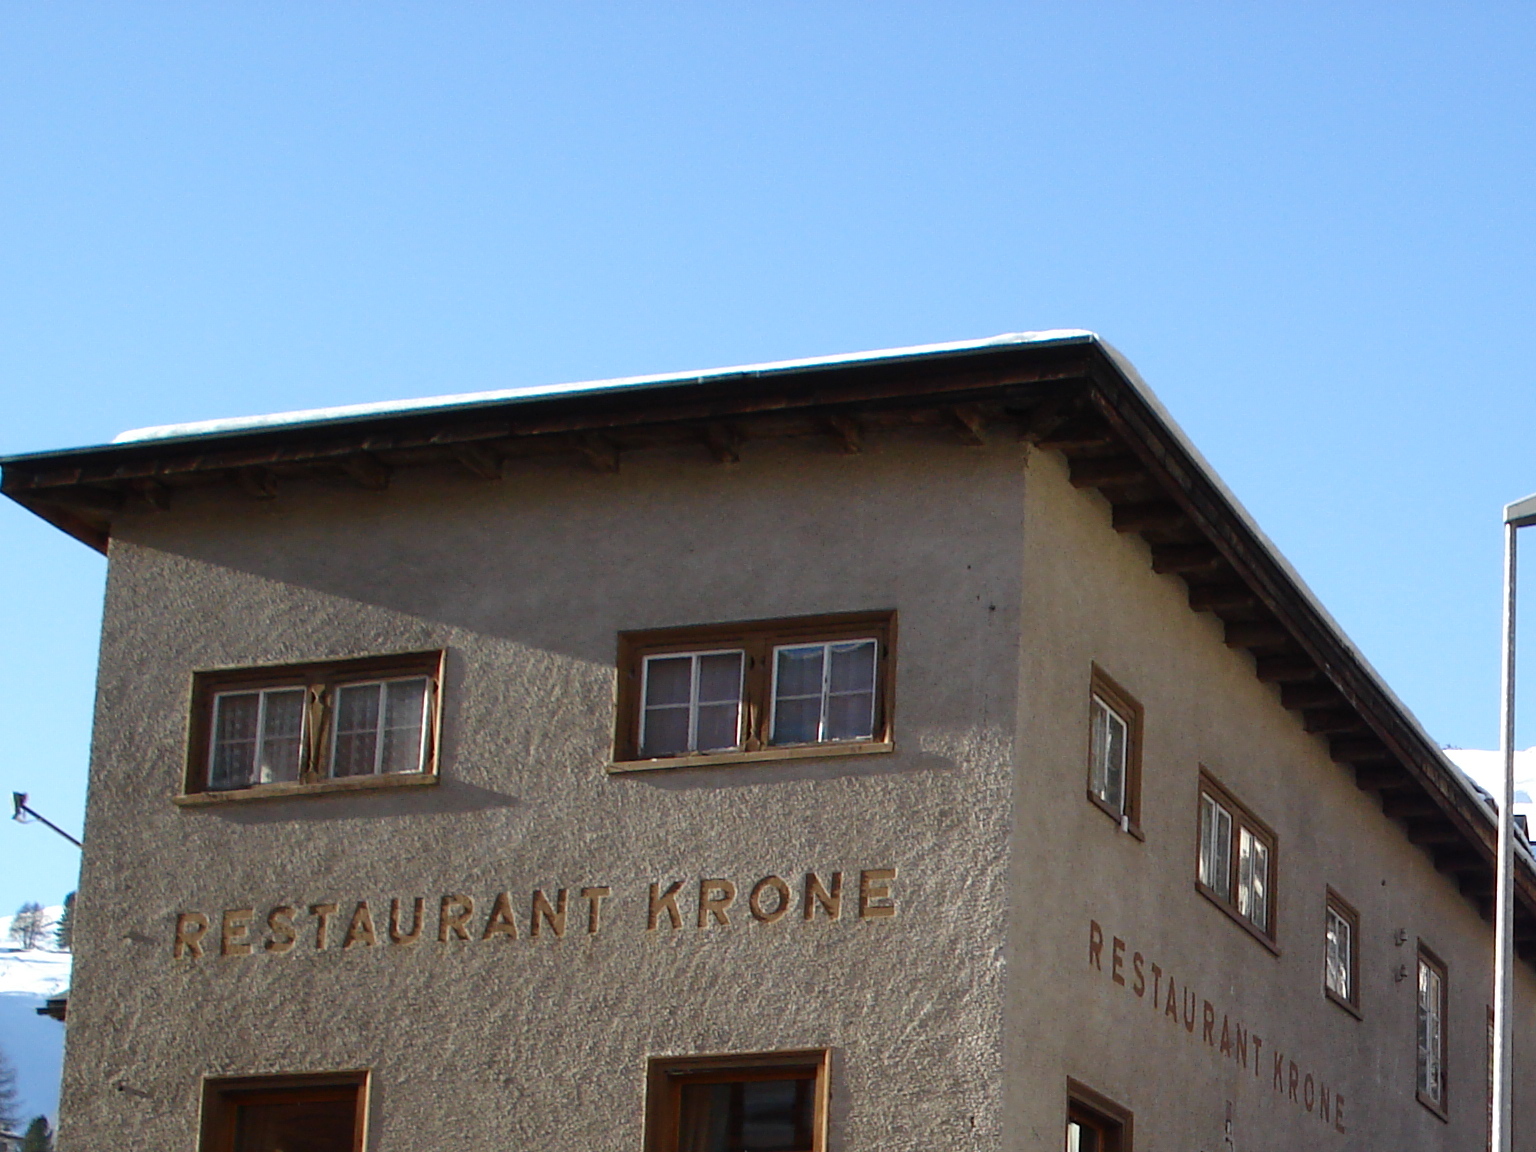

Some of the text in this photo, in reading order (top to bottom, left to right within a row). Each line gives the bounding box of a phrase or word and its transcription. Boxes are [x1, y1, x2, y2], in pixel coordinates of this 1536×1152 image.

[172, 867, 899, 961] RESTAURANT KRONE
[1088, 918, 1346, 1135] RESTAURANT KRONE
